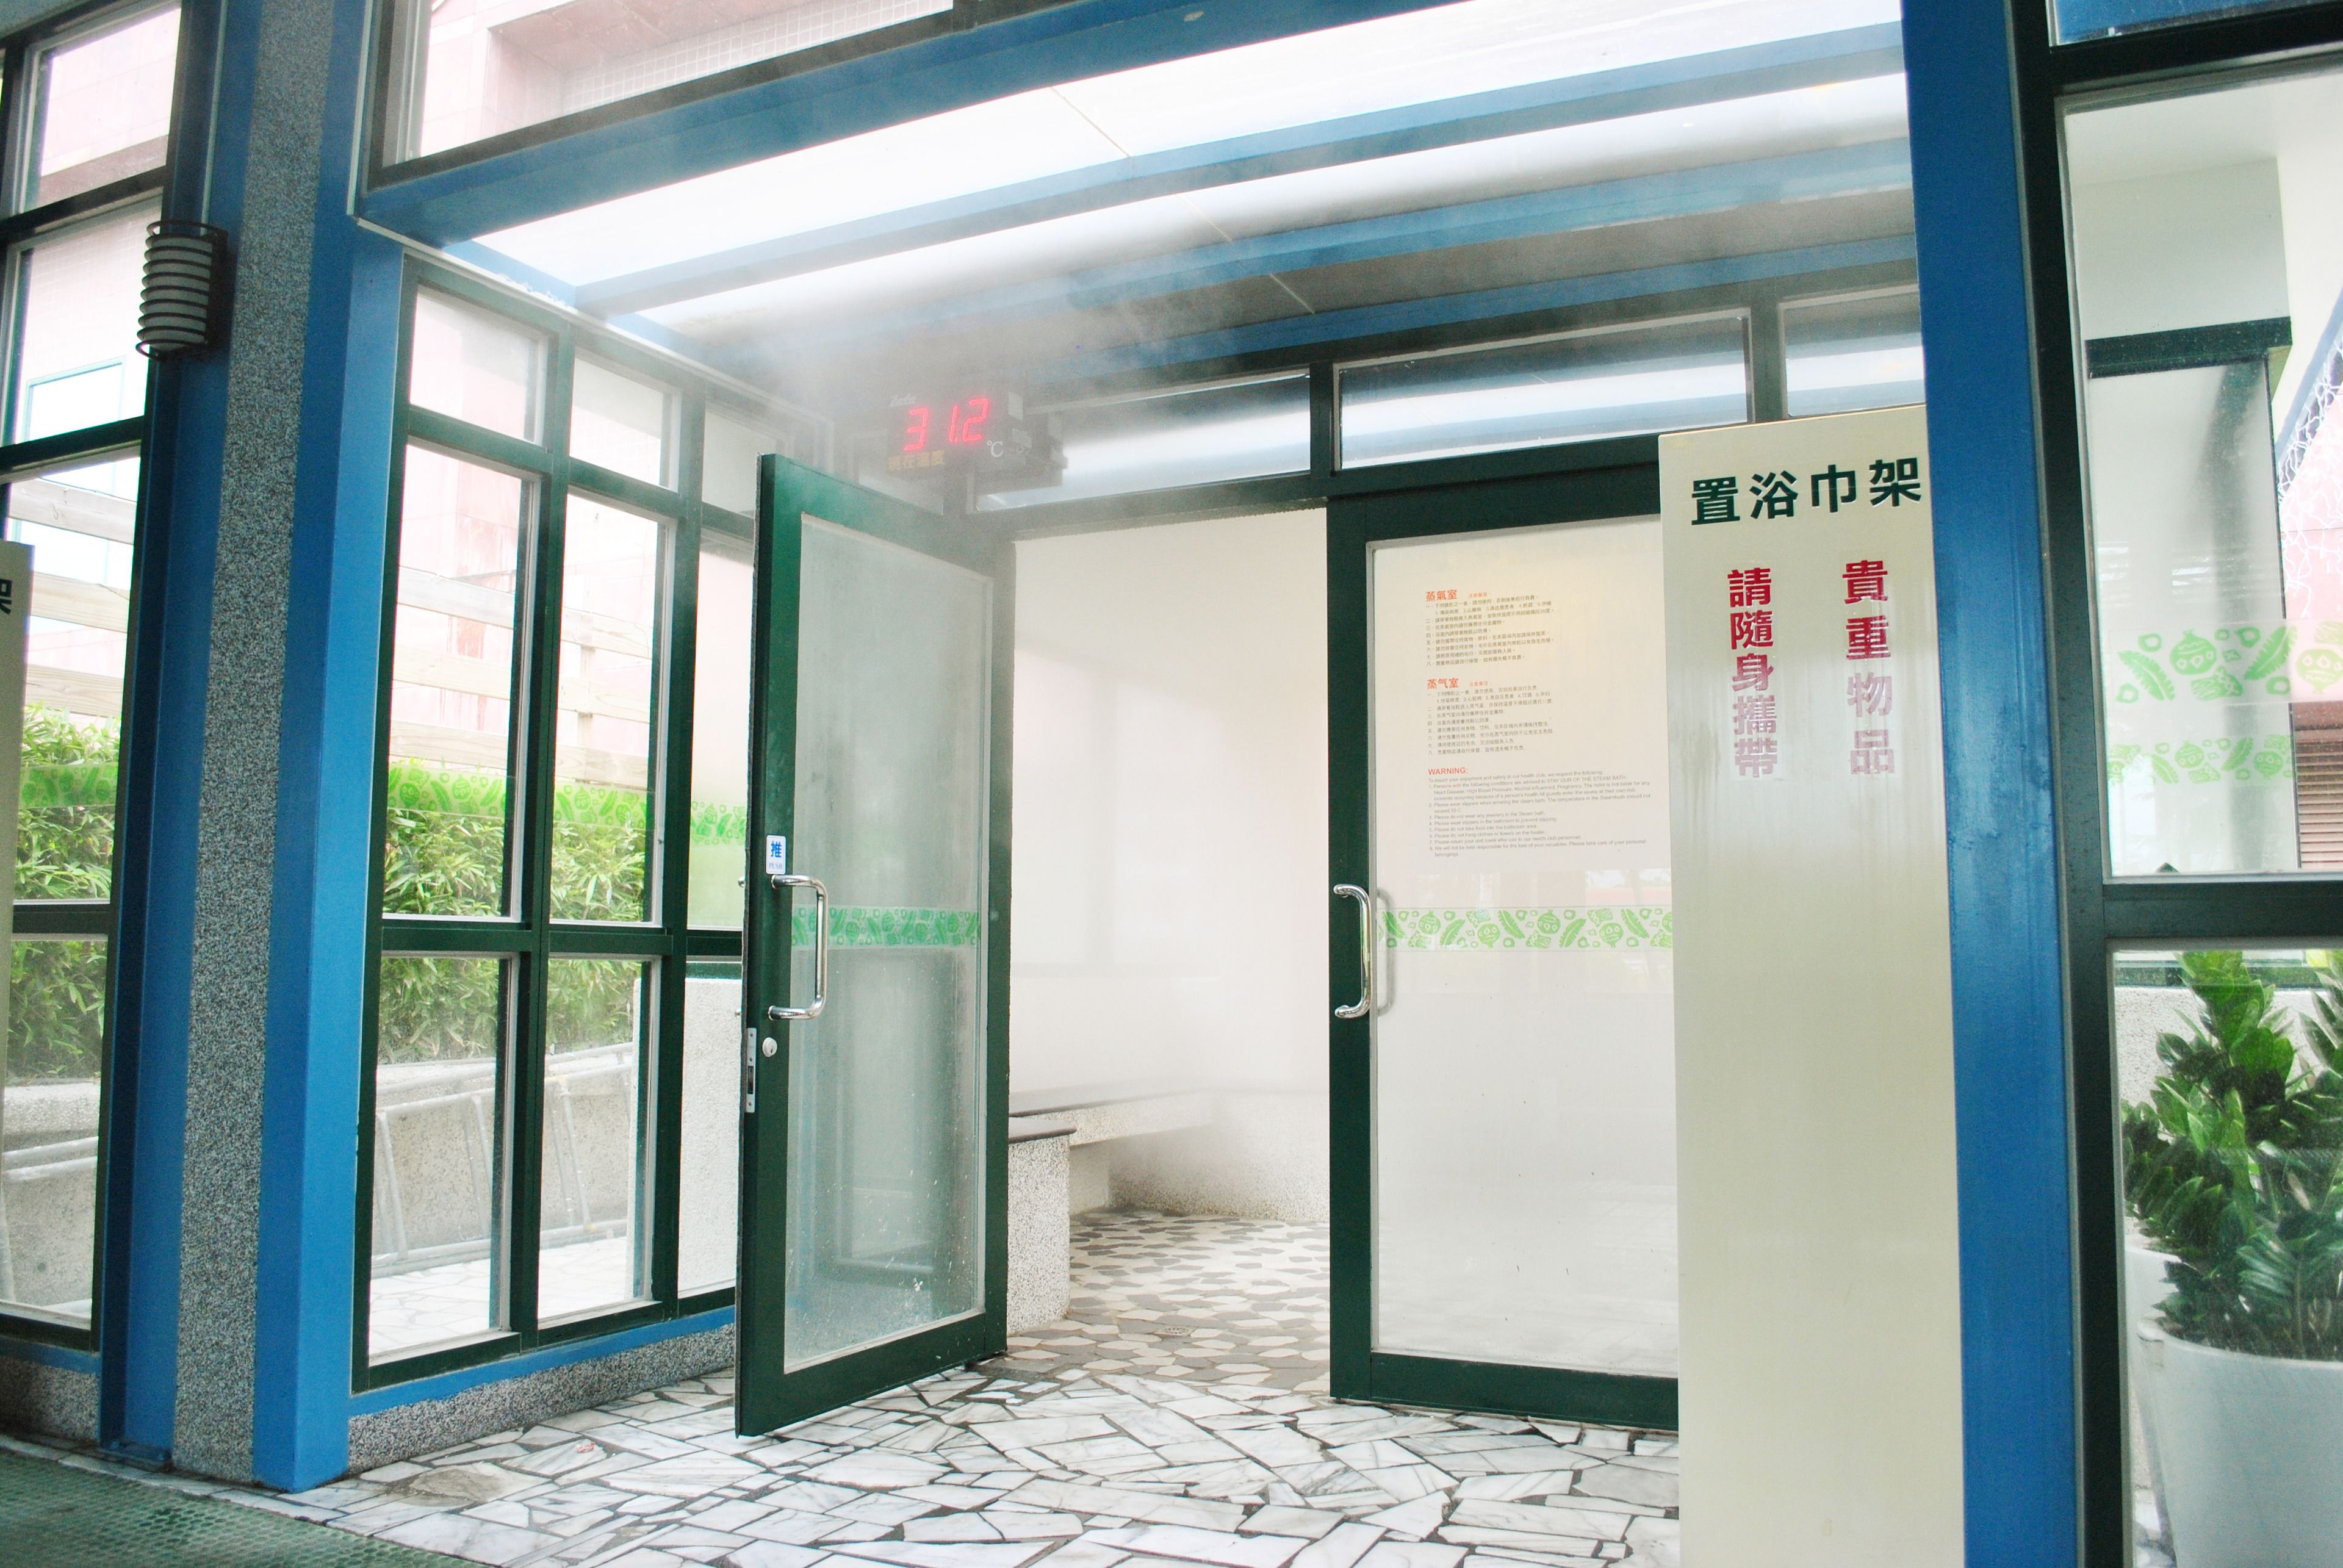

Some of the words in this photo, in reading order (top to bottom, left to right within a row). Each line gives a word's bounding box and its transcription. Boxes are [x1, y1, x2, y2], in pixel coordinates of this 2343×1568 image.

[1691, 456, 1922, 527] 置浴巾架
[1425, 589, 1458, 602] 蒸氣室
[1727, 567, 1777, 778] 請隨身攜帶
[1841, 559, 1895, 775] 貴重物品
[1427, 677, 1459, 689] 蒸气室
[1428, 766, 1469, 775] WARNING:
[771, 840, 782, 858] 推
